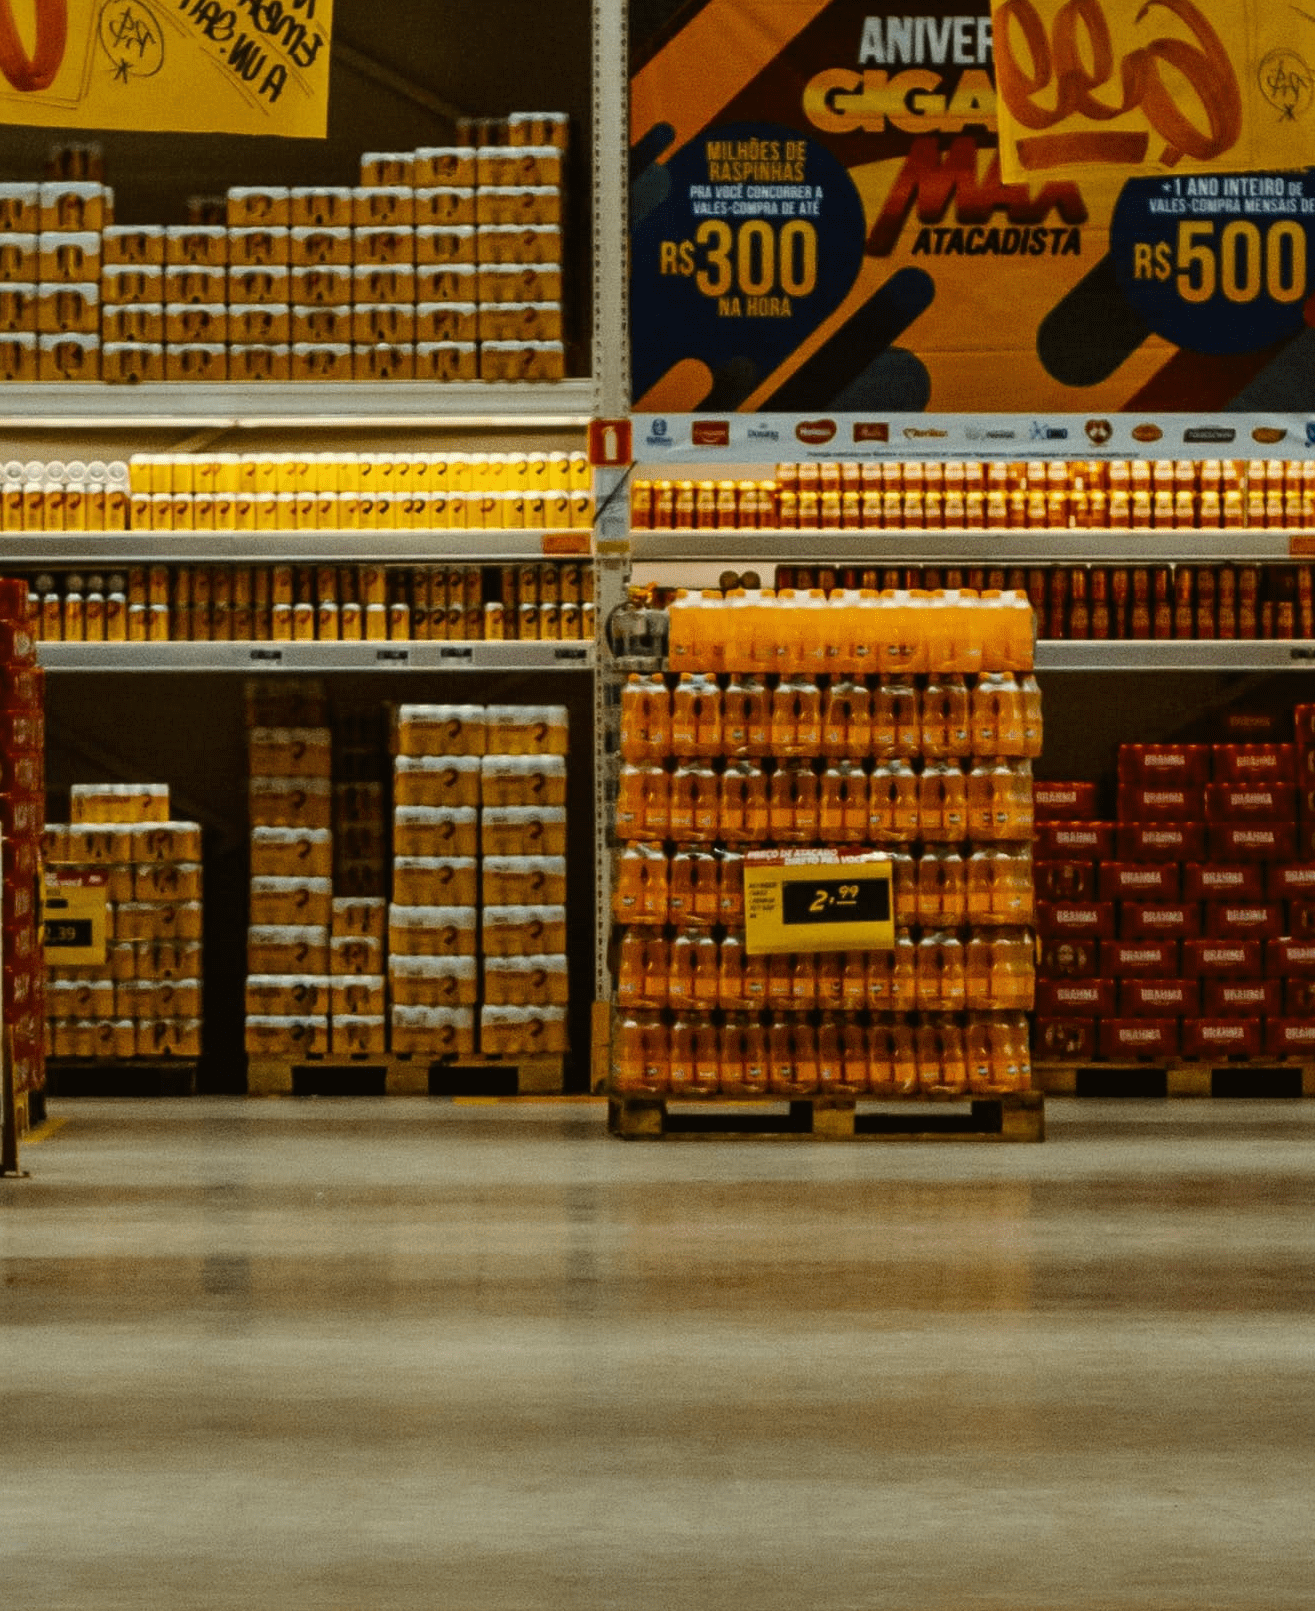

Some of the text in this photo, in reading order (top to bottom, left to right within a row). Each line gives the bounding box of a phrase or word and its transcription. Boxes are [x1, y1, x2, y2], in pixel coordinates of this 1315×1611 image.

[803, 69, 998, 134] GIGA
[707, 138, 806, 160] MILHÕES DE
[710, 161, 804, 181] RASPINHAS
[690, 185, 712, 198] PRA
[1187, 177, 1219, 196] ANO
[1224, 177, 1284, 196] INTEIRO
[782, 201, 796, 214] DE
[1244, 198, 1297, 213] MENSAIS
[1301, 198, 1315, 213] DE
[911, 226, 1080, 256] ATACADISTA
[718, 297, 791, 318] NA HORA
